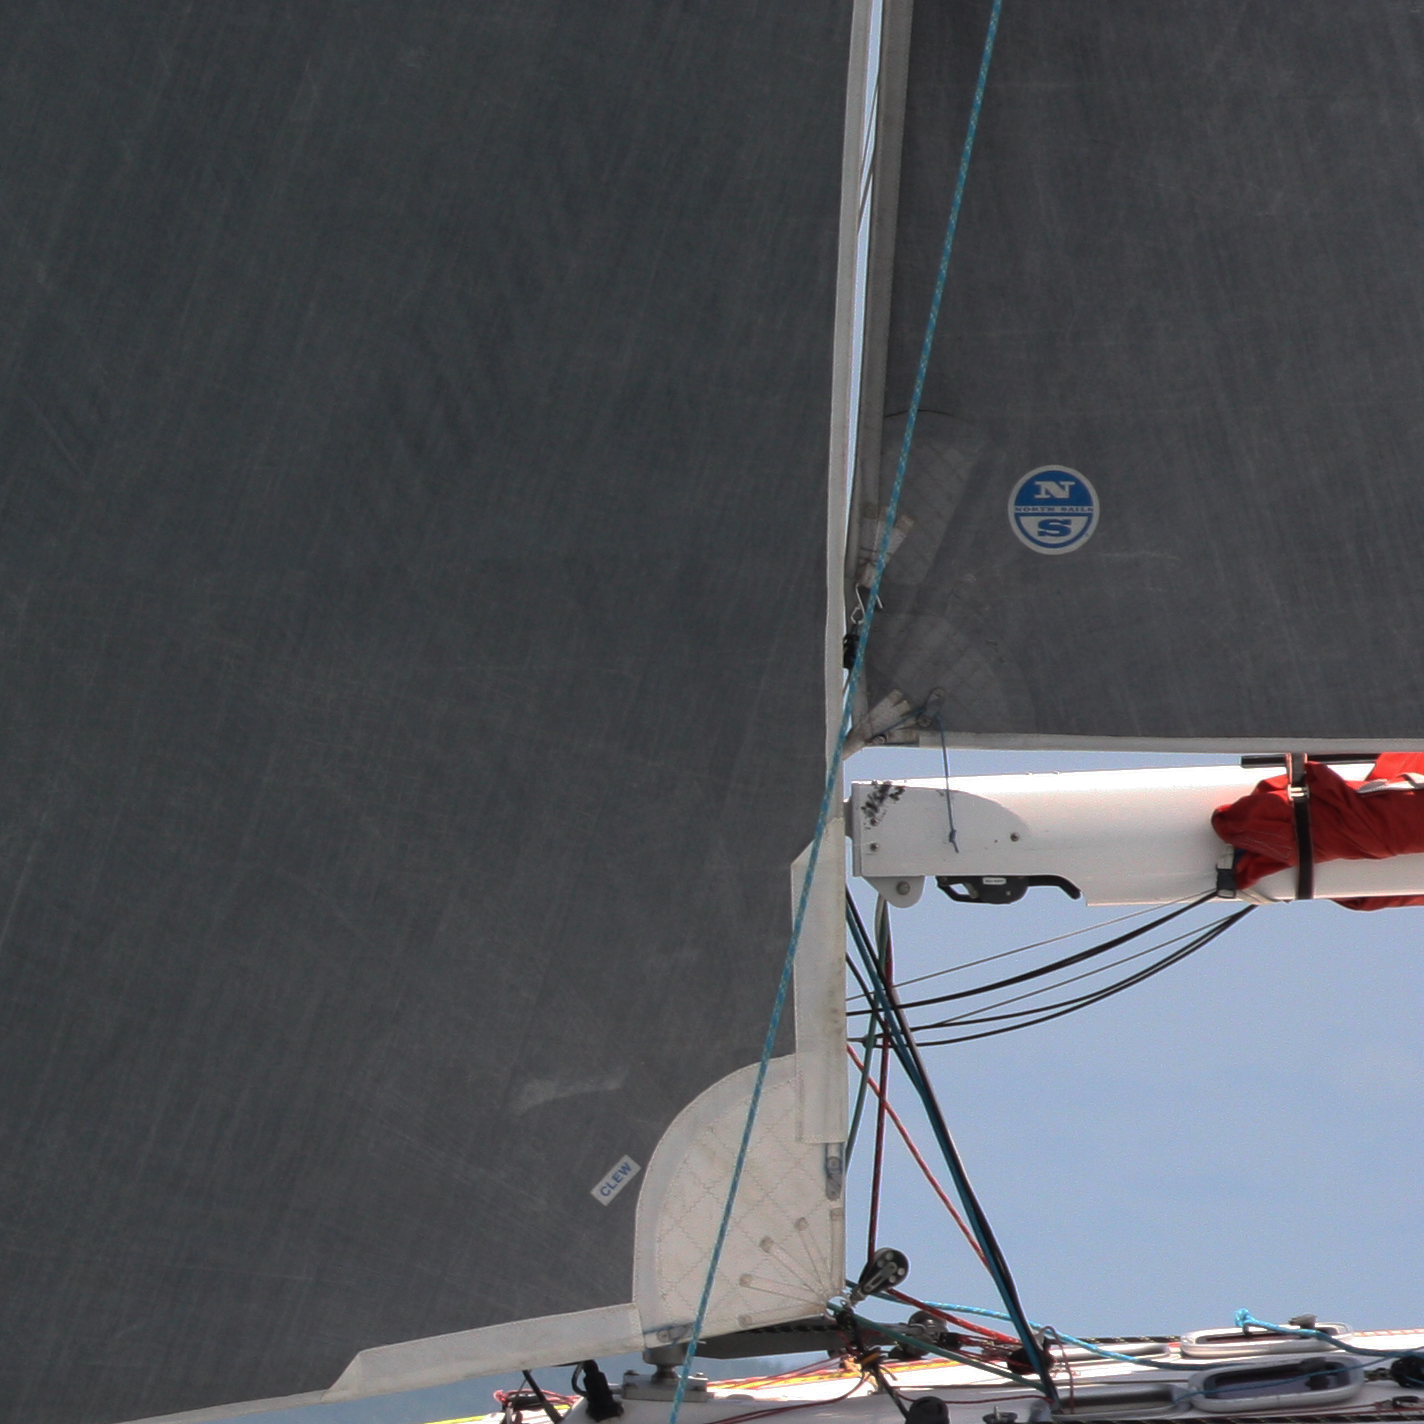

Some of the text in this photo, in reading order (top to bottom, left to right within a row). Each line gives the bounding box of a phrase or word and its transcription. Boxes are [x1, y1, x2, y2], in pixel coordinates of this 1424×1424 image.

[1034, 480, 1076, 499] N
[1037, 519, 1072, 537] S
[599, 1162, 632, 1197] CLEW
